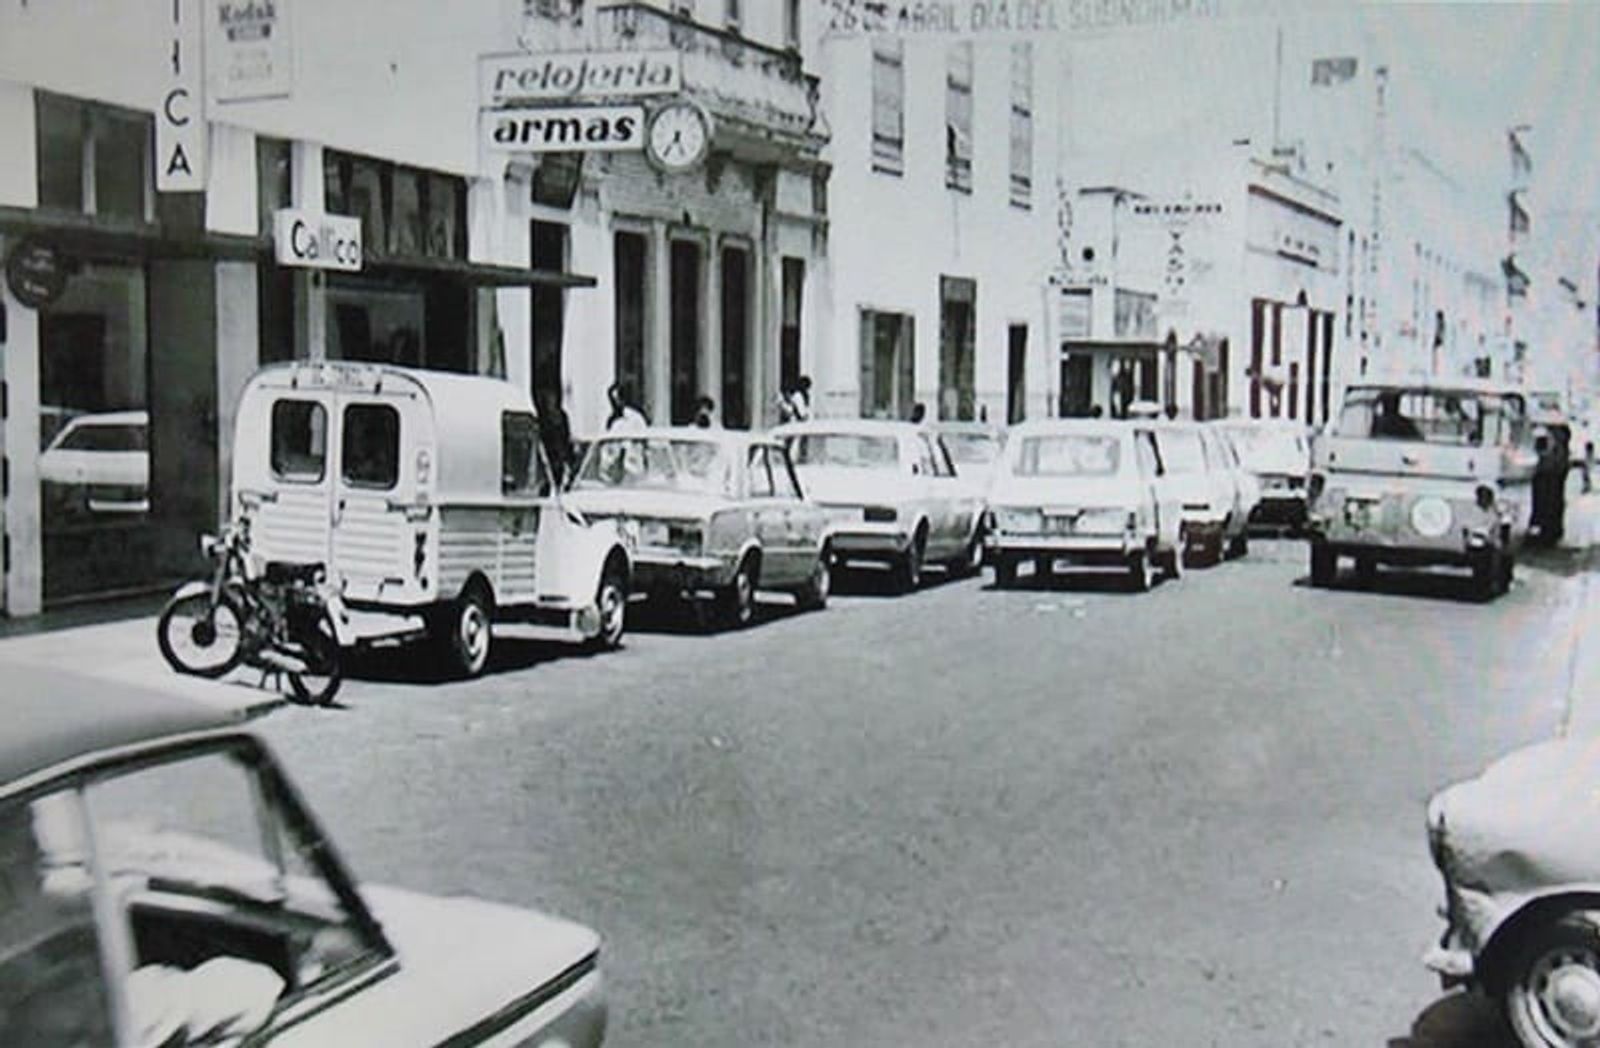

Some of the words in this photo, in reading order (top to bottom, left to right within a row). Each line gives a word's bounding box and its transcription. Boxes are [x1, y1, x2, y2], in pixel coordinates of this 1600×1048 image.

[218, 0, 278, 25] Kodak
[895, 3, 960, 32] ABRIL
[493, 115, 636, 144] armas
